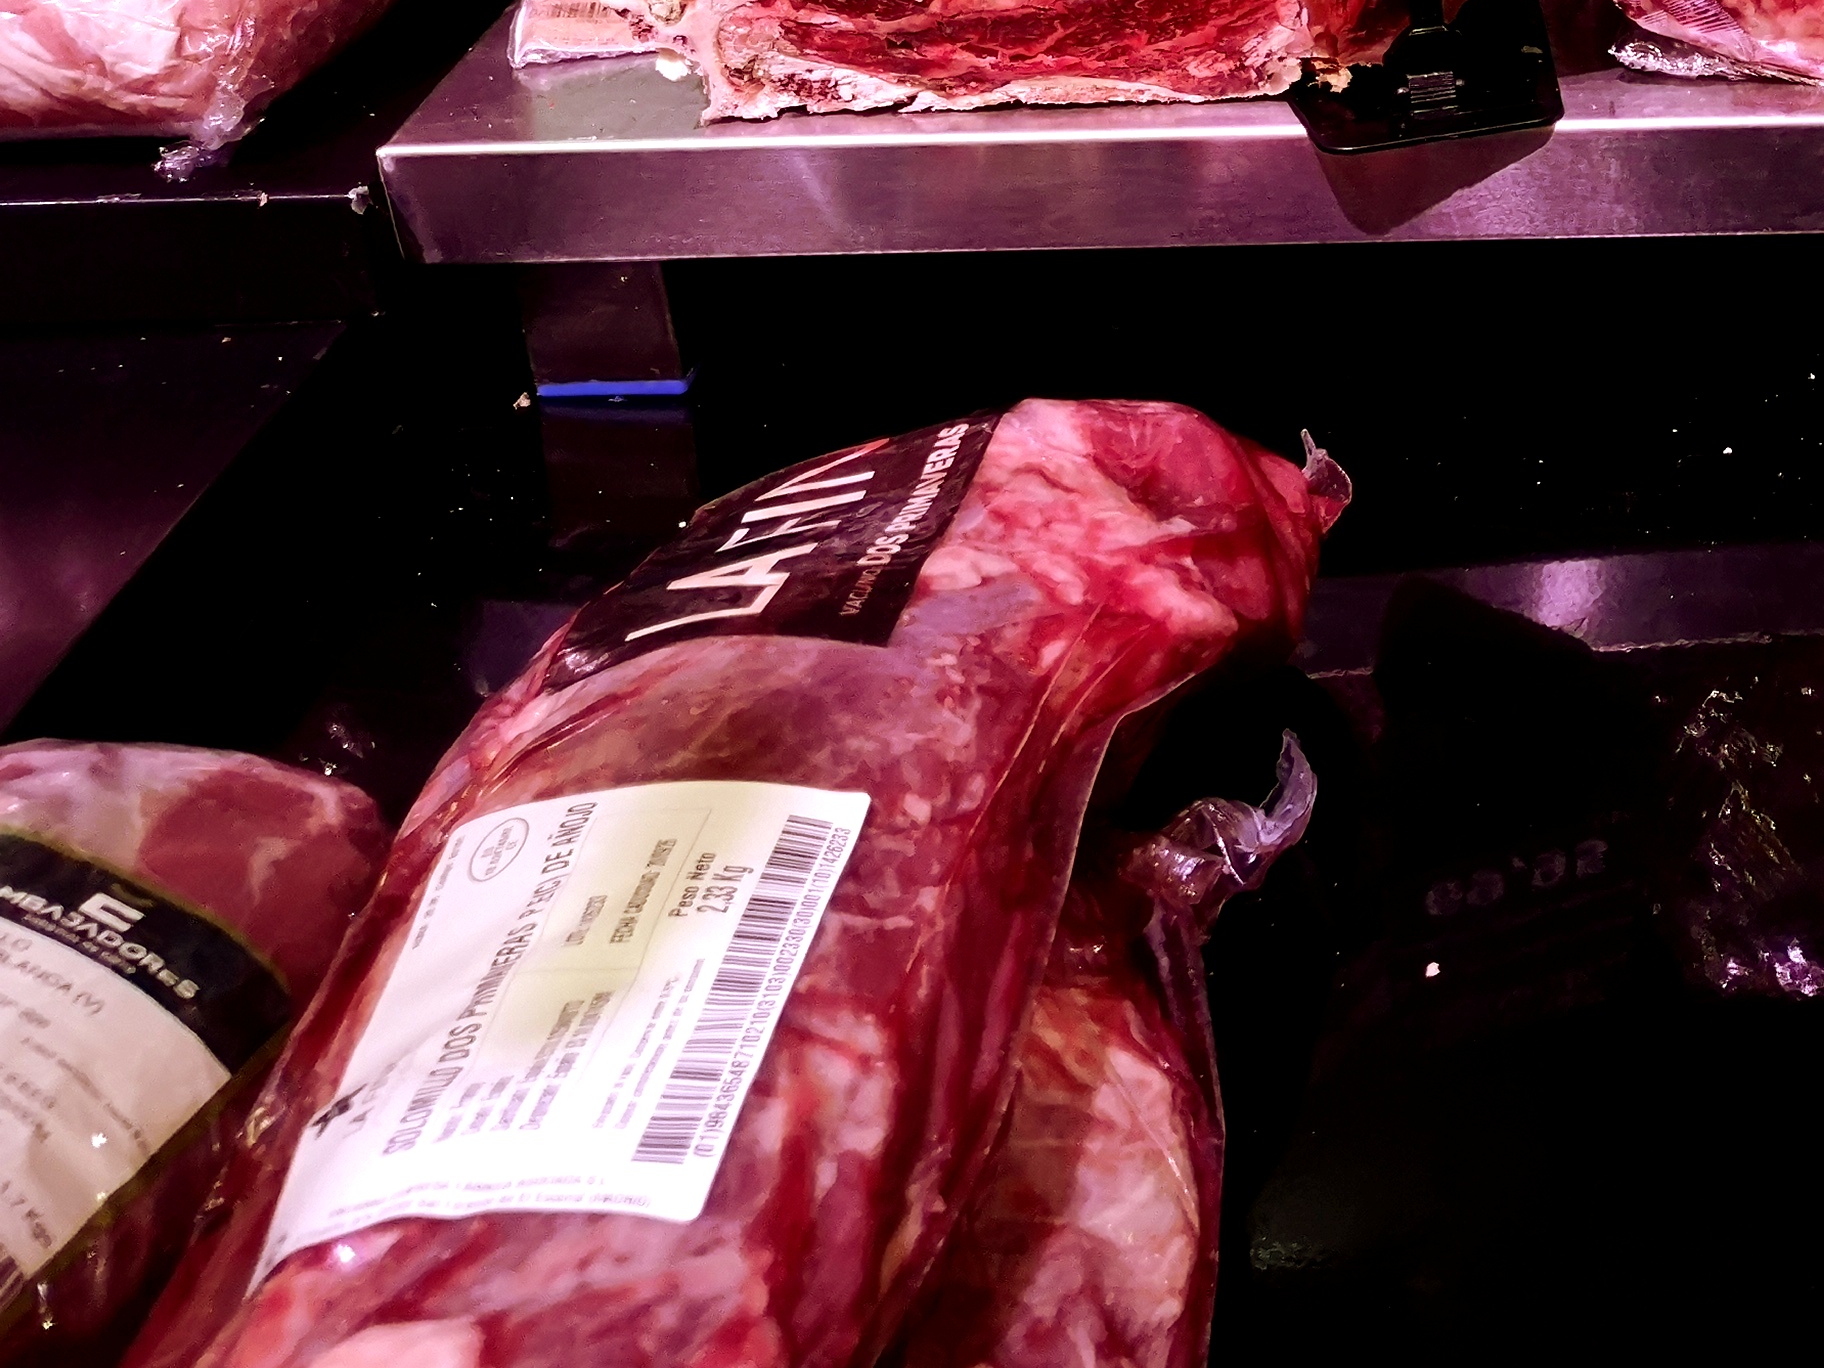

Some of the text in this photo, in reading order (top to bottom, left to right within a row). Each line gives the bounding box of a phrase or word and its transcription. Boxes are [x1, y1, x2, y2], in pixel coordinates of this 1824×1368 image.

[839, 422, 970, 618] VACUNO DOS PRIMAVERAS
[548, 800, 599, 848] AÑOJO
[541, 848, 574, 875] DE
[668, 851, 717, 918] Peso Neto
[697, 863, 755, 914] 2,33 Kg
[457, 922, 538, 1021] PRIMAVERAS
[438, 1022, 483, 1064] DOS
